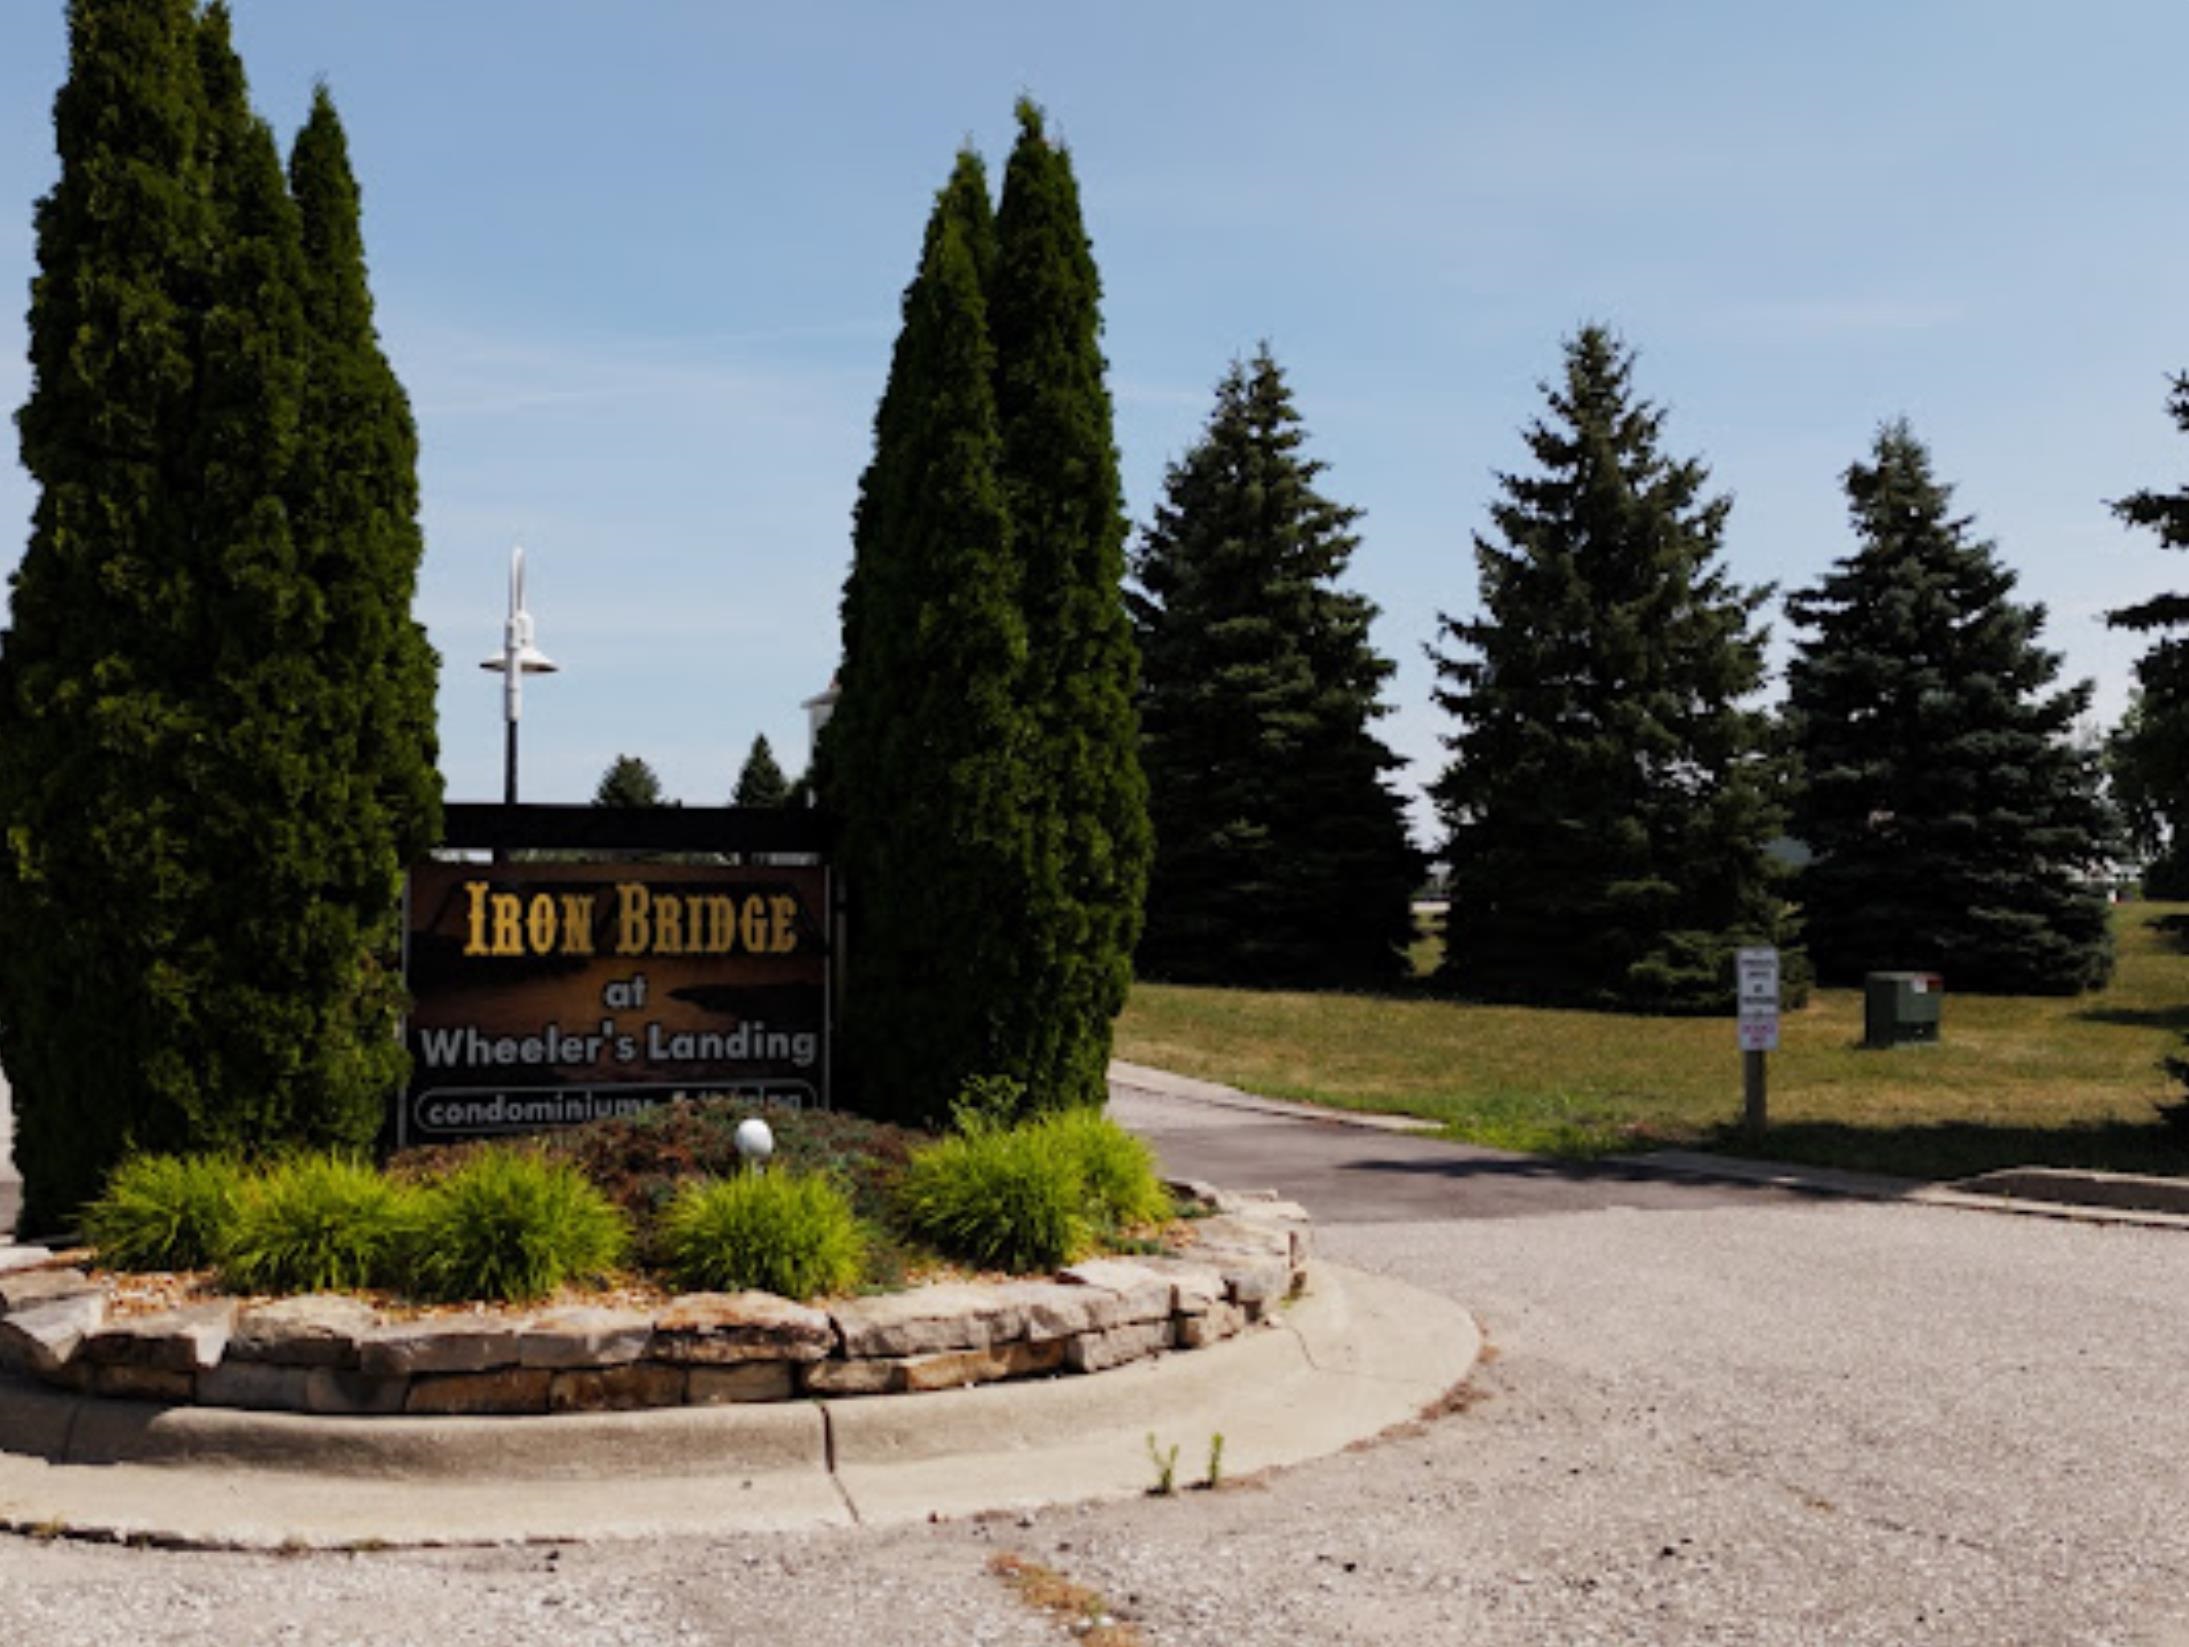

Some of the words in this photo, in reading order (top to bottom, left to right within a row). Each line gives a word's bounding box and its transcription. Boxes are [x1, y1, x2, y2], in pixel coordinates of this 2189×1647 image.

[464, 882, 595, 956] IRON
[616, 883, 797, 954] BRIDGE
[605, 975, 647, 1006] at
[421, 1021, 637, 1066] Wheeler's
[648, 1021, 817, 1065] Landing
